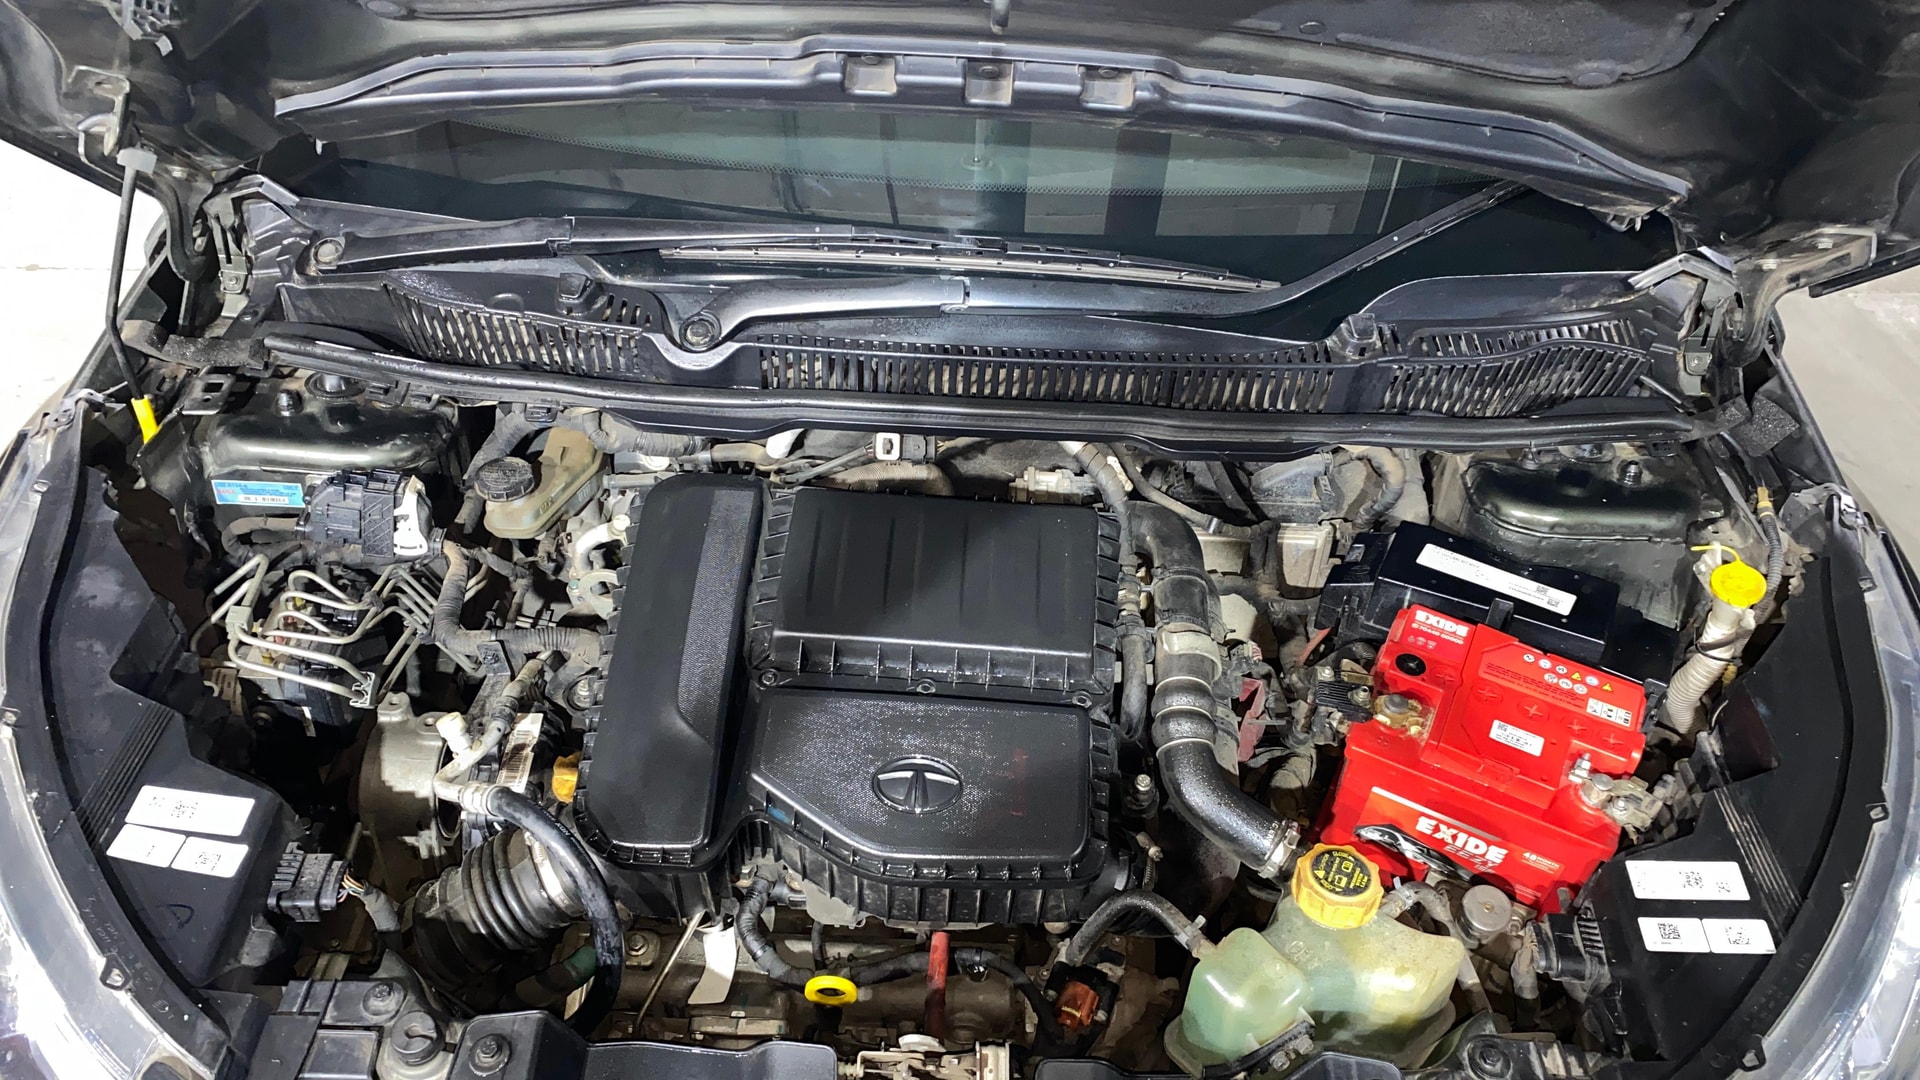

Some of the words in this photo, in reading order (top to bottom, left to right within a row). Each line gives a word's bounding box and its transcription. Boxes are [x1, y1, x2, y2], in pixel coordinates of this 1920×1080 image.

[1415, 610, 1469, 637] EXIDE
[1415, 816, 1509, 863] EXIDE
[1444, 844, 1499, 868] EEZY
[1522, 851, 1537, 861] 48
